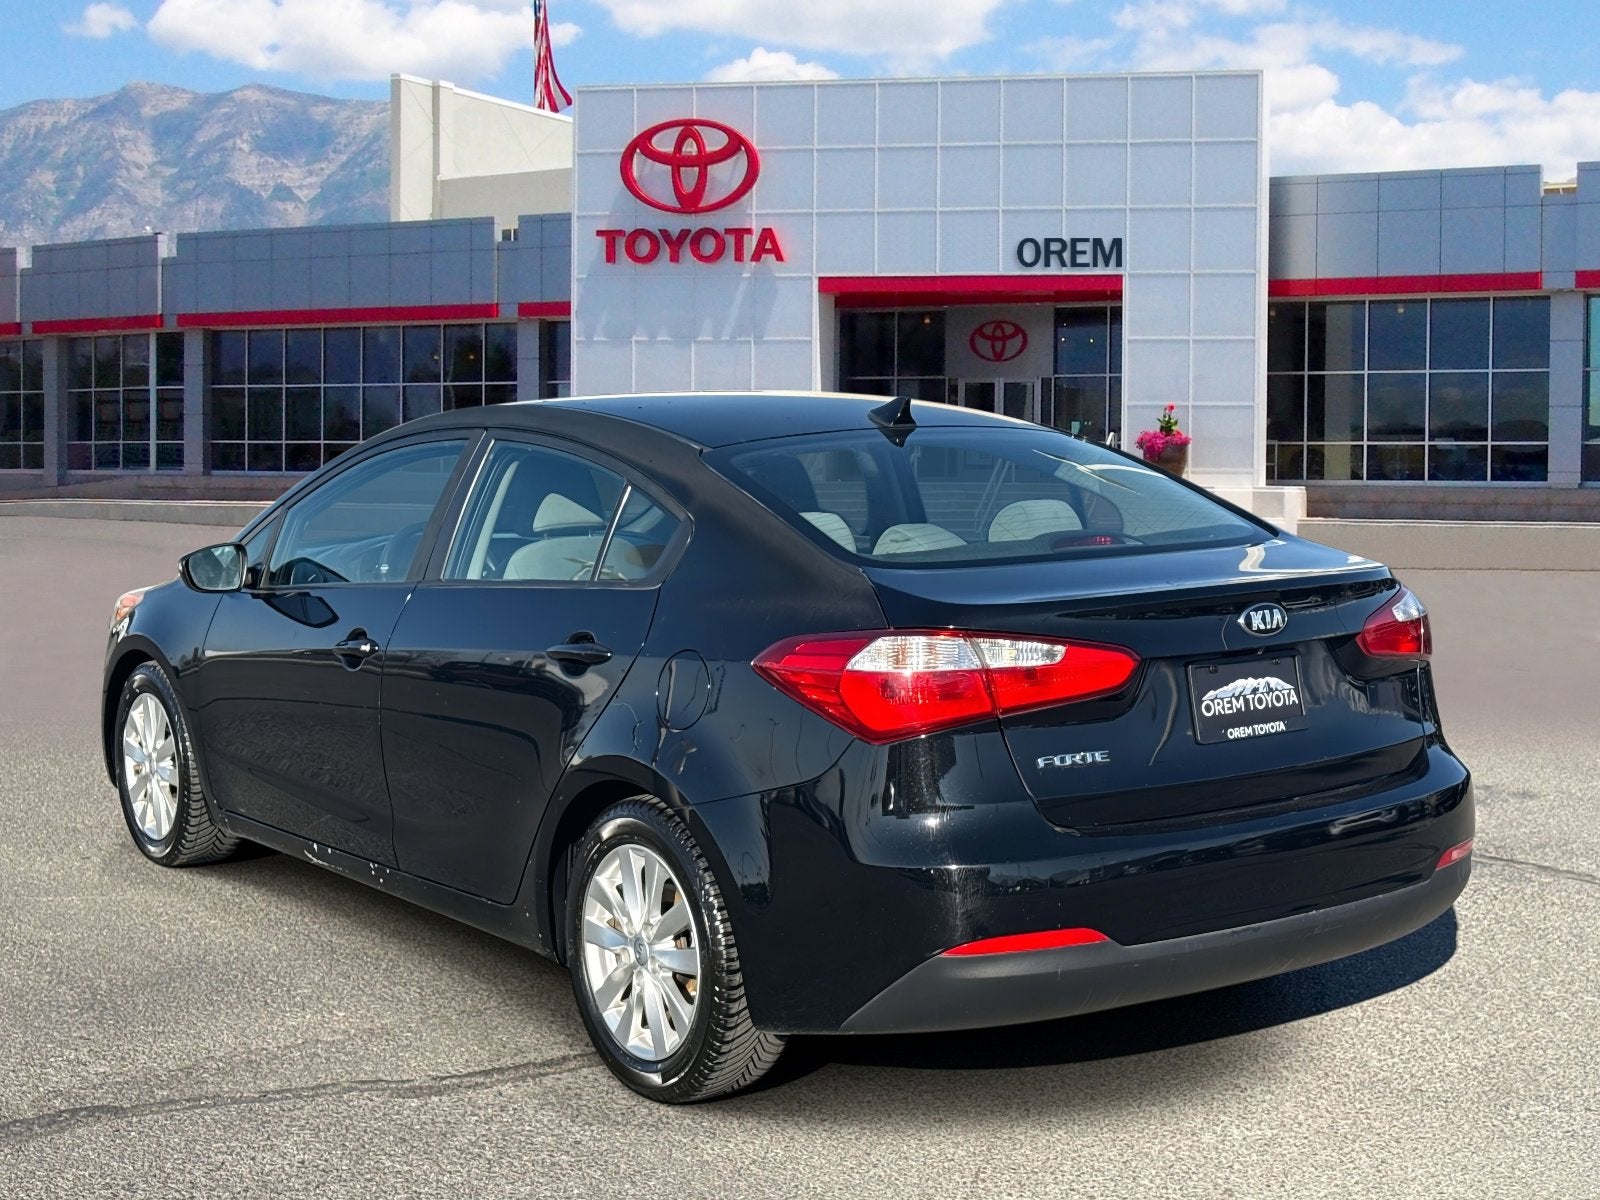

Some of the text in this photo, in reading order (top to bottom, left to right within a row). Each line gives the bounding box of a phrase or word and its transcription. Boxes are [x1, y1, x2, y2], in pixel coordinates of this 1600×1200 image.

[596, 227, 785, 264] TOYOTA
[1016, 237, 1123, 268] OREM
[1250, 608, 1284, 631] KIA
[1201, 689, 1298, 717] OREM TOYOTA
[1227, 721, 1286, 739] OREM TOYOTA
[1037, 750, 1111, 768] FORTE
